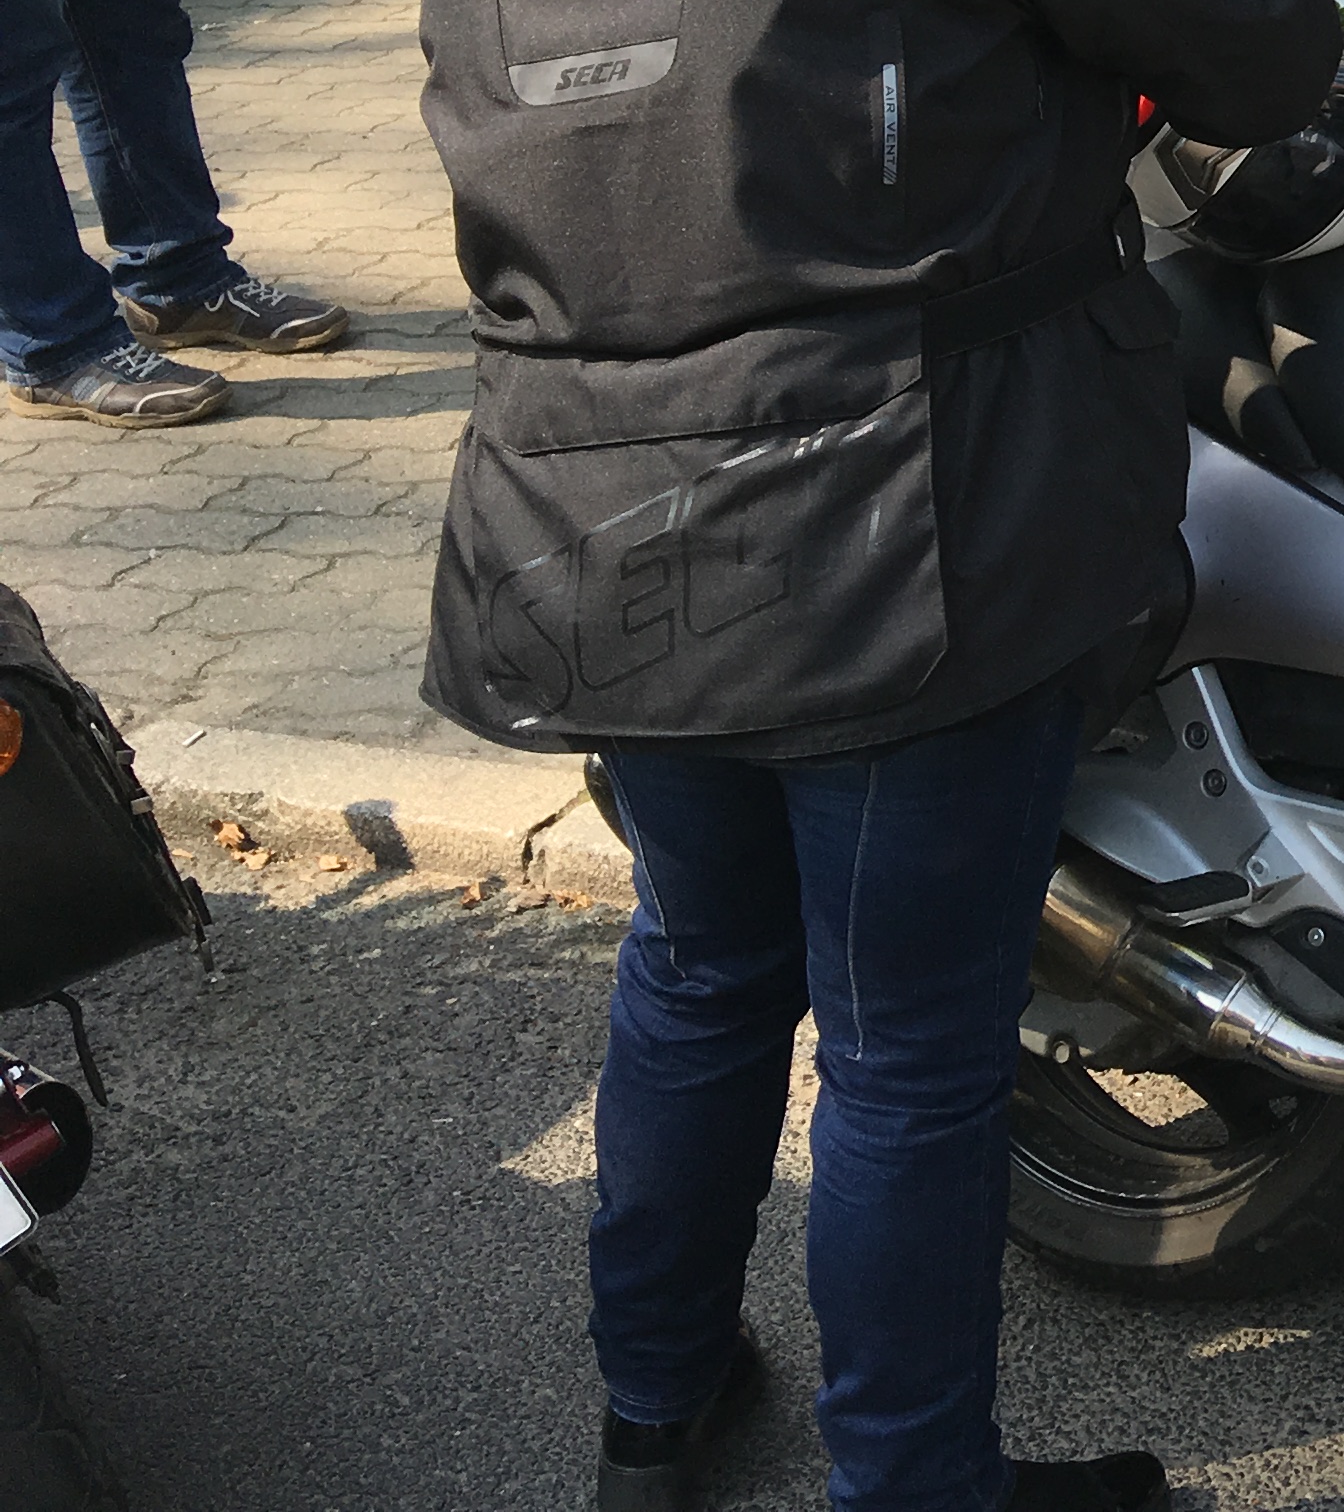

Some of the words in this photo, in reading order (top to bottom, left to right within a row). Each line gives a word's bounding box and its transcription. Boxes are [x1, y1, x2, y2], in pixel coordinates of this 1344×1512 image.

[554, 58, 632, 91] SECA
[885, 85, 896, 113] AIR
[886, 121, 897, 166] VENT
